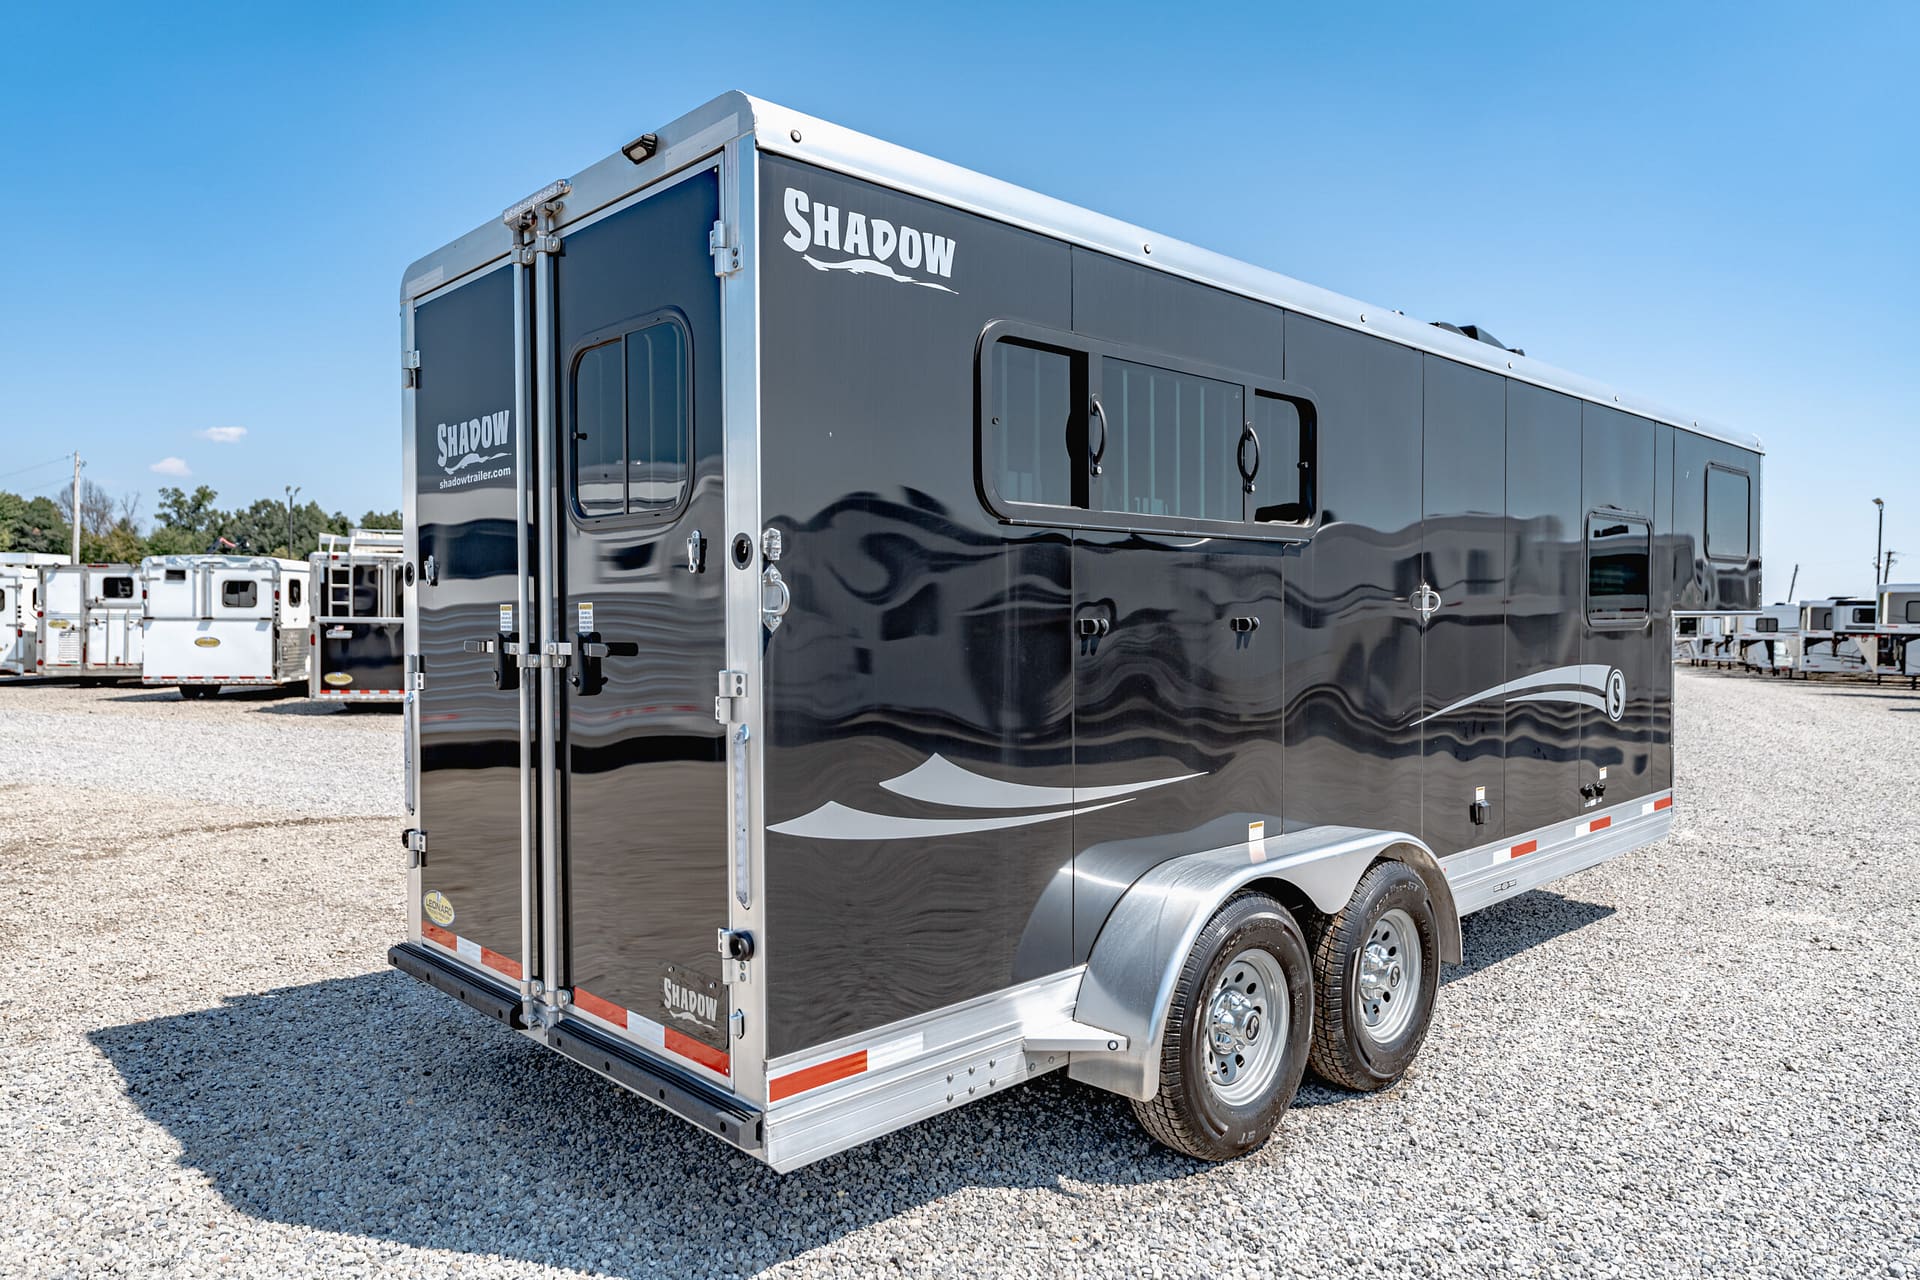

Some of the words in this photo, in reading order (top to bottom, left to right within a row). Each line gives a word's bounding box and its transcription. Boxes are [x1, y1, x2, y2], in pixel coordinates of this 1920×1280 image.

[783, 187, 956, 278] SHADOW
[437, 409, 510, 467] SHADOW
[439, 466, 511, 489] shadowtrailer.com
[663, 977, 718, 1022] SHADOW
